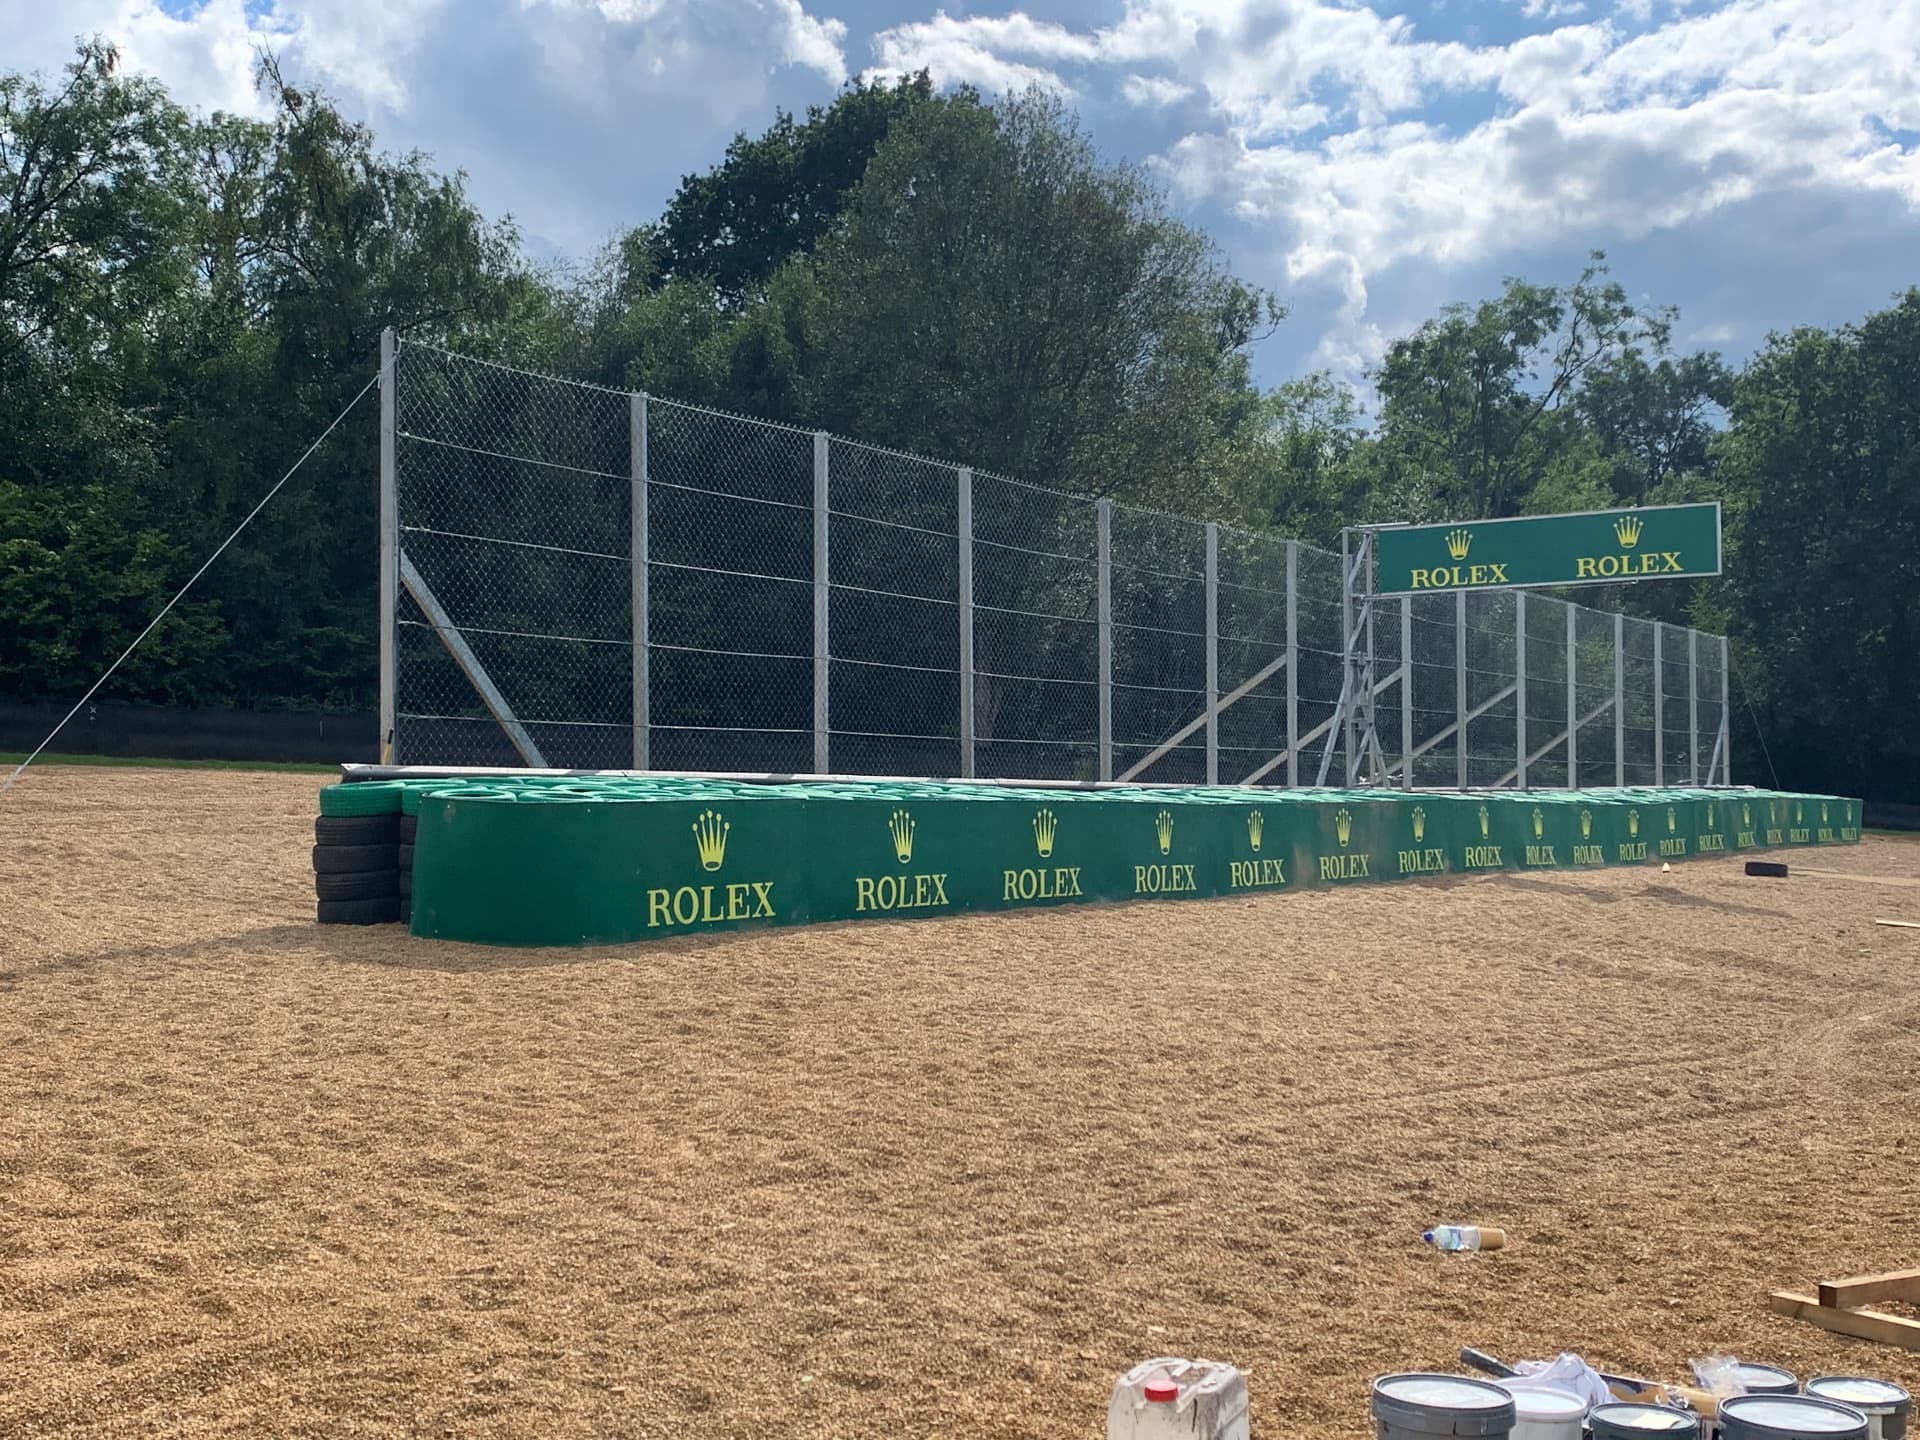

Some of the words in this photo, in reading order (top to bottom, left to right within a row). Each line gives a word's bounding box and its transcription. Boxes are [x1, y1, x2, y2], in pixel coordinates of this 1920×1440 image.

[1411, 563, 1509, 589] ROLEX
[1576, 551, 1684, 578] ROLEX
[1398, 848, 1444, 873] ROLEX
[1464, 845, 1504, 867] ROLEX
[1525, 845, 1557, 865] ROLEX
[1573, 845, 1605, 864] ROLEX
[1619, 842, 1647, 861] ROLEX
[1659, 838, 1686, 857] ROLEX
[1135, 864, 1197, 893] ROLEX
[1230, 859, 1286, 888] ROLEX
[1320, 853, 1369, 881] ROLEX
[856, 874, 949, 911] ROLEX
[1003, 866, 1083, 901] ROLEX
[647, 881, 776, 928] ROLEX
